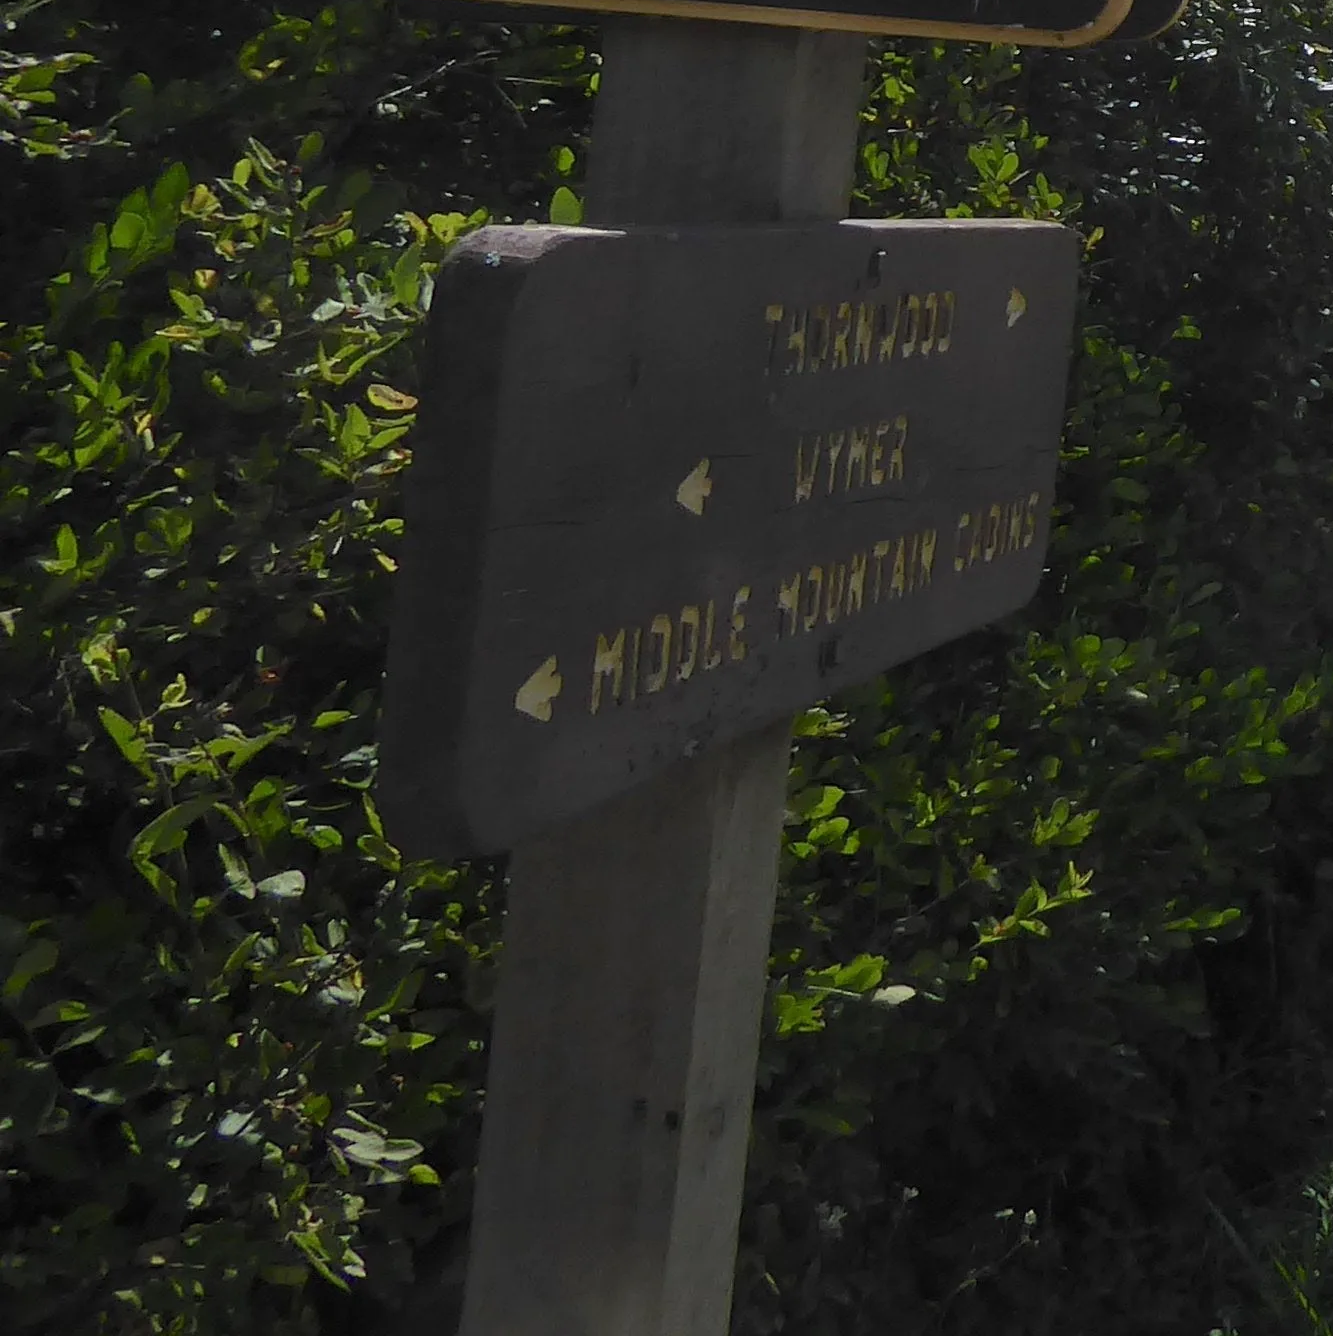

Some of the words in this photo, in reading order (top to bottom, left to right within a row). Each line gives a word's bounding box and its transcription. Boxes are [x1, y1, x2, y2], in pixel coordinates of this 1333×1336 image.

[764, 290, 955, 375] THORNWOOD
[795, 414, 908, 504] WYMER
[590, 585, 751, 716] MIDDLE
[776, 528, 938, 641] MOUNTAIN
